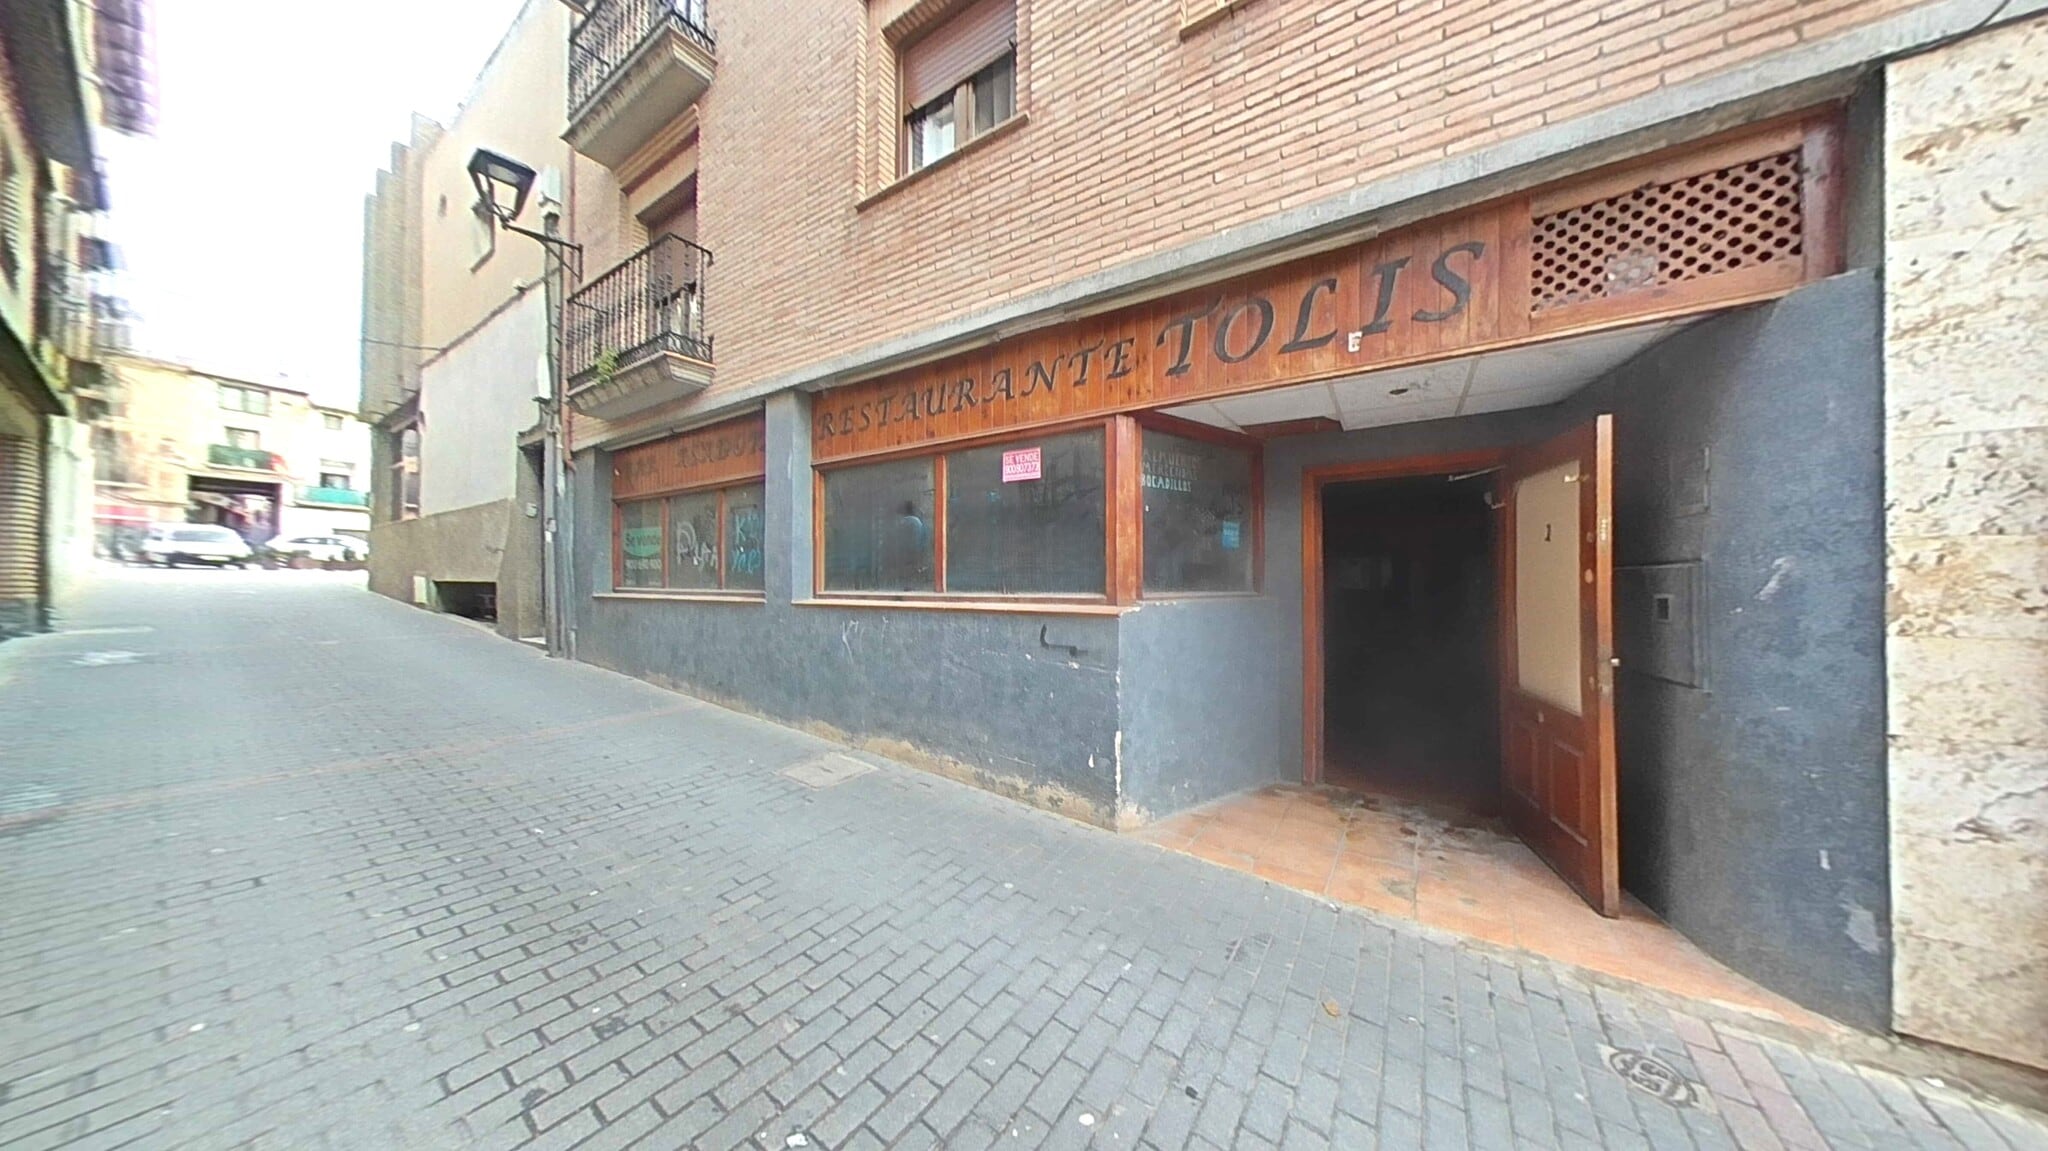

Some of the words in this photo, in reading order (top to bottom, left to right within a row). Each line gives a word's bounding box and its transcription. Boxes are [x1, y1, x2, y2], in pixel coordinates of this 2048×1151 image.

[818, 337, 1136, 440] RESTAURANTE
[1156, 240, 1486, 377] TOLIS
[1015, 451, 1039, 464] VENDE
[1141, 472, 1192, 493] BOCADILLOS
